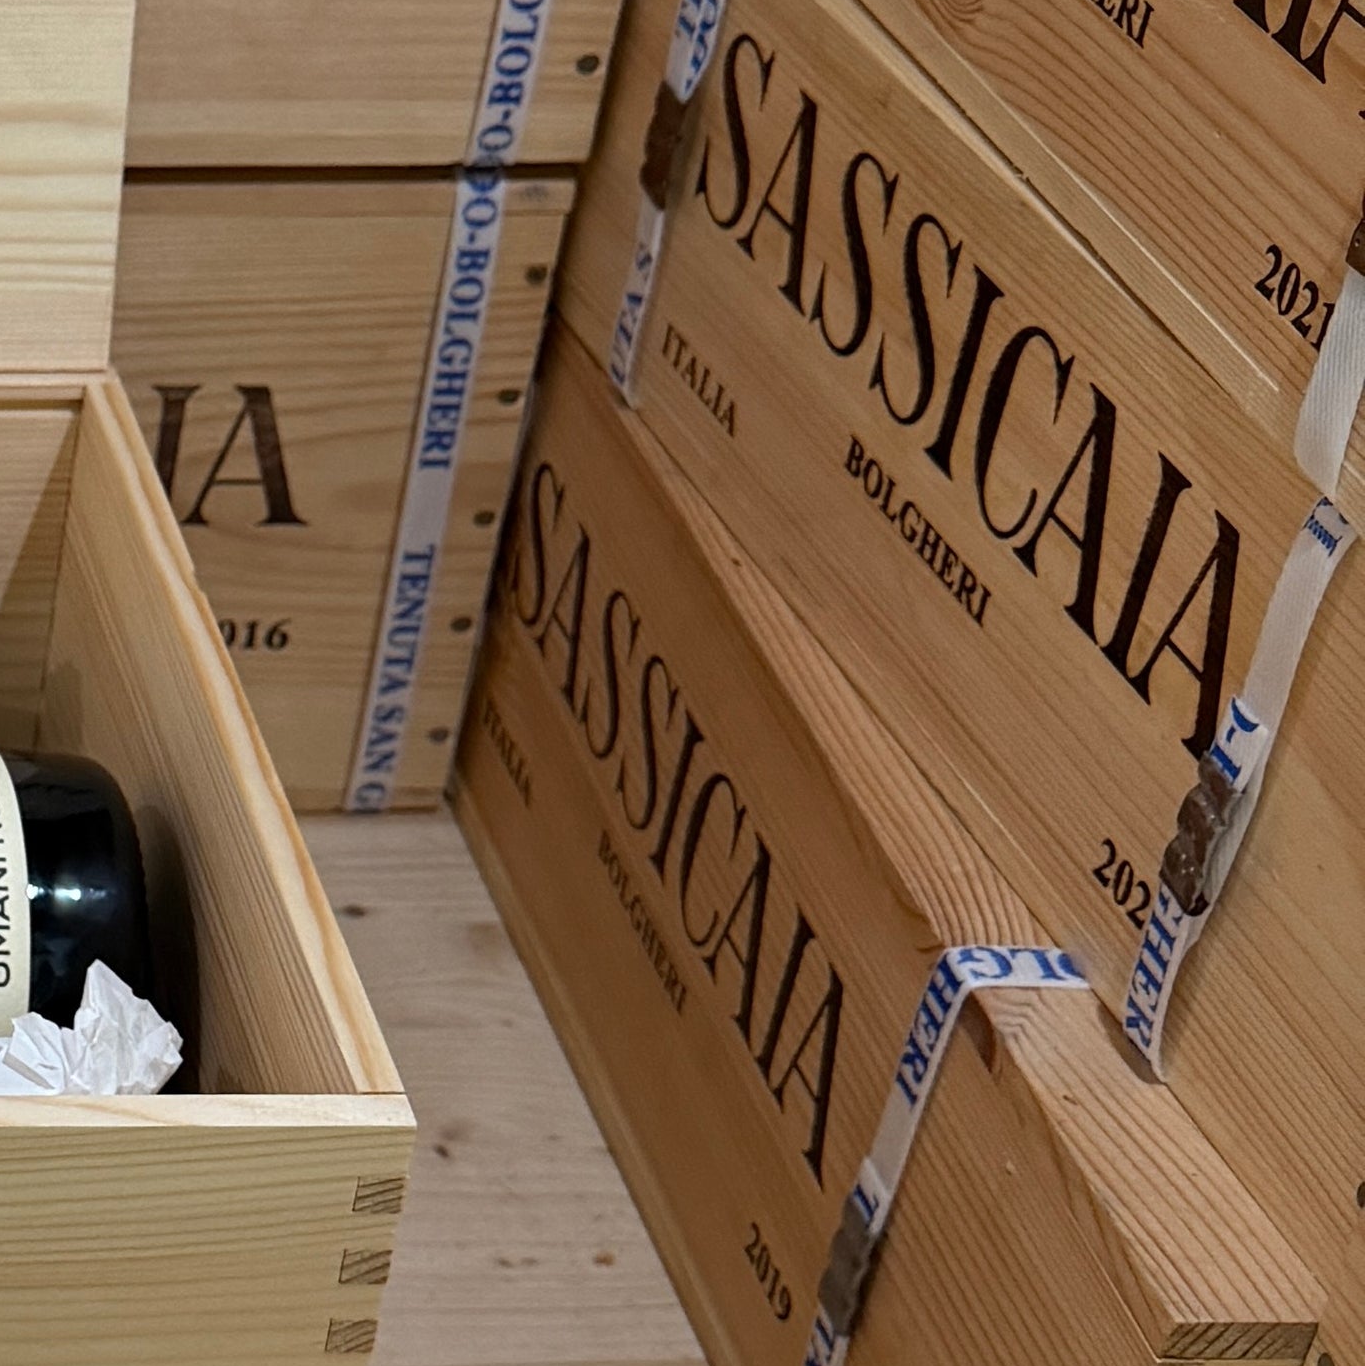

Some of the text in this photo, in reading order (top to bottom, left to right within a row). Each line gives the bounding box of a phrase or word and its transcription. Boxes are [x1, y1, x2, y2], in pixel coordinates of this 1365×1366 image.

[1254, 243, 1335, 352] 2021
[660, 324, 738, 438] ITALIA
[696, 34, 1240, 760] SASSICAIA
[844, 435, 992, 629] BOLGHERI
[378, 543, 435, 699] TENUTA
[362, 703, 410, 780] SAN
[482, 697, 534, 810] ITALIA
[512, 462, 844, 1192] SASSICAIA
[1092, 837, 1153, 929] 202
[596, 829, 687, 1015] BOLGHERI
[742, 1222, 792, 1323] 2019
